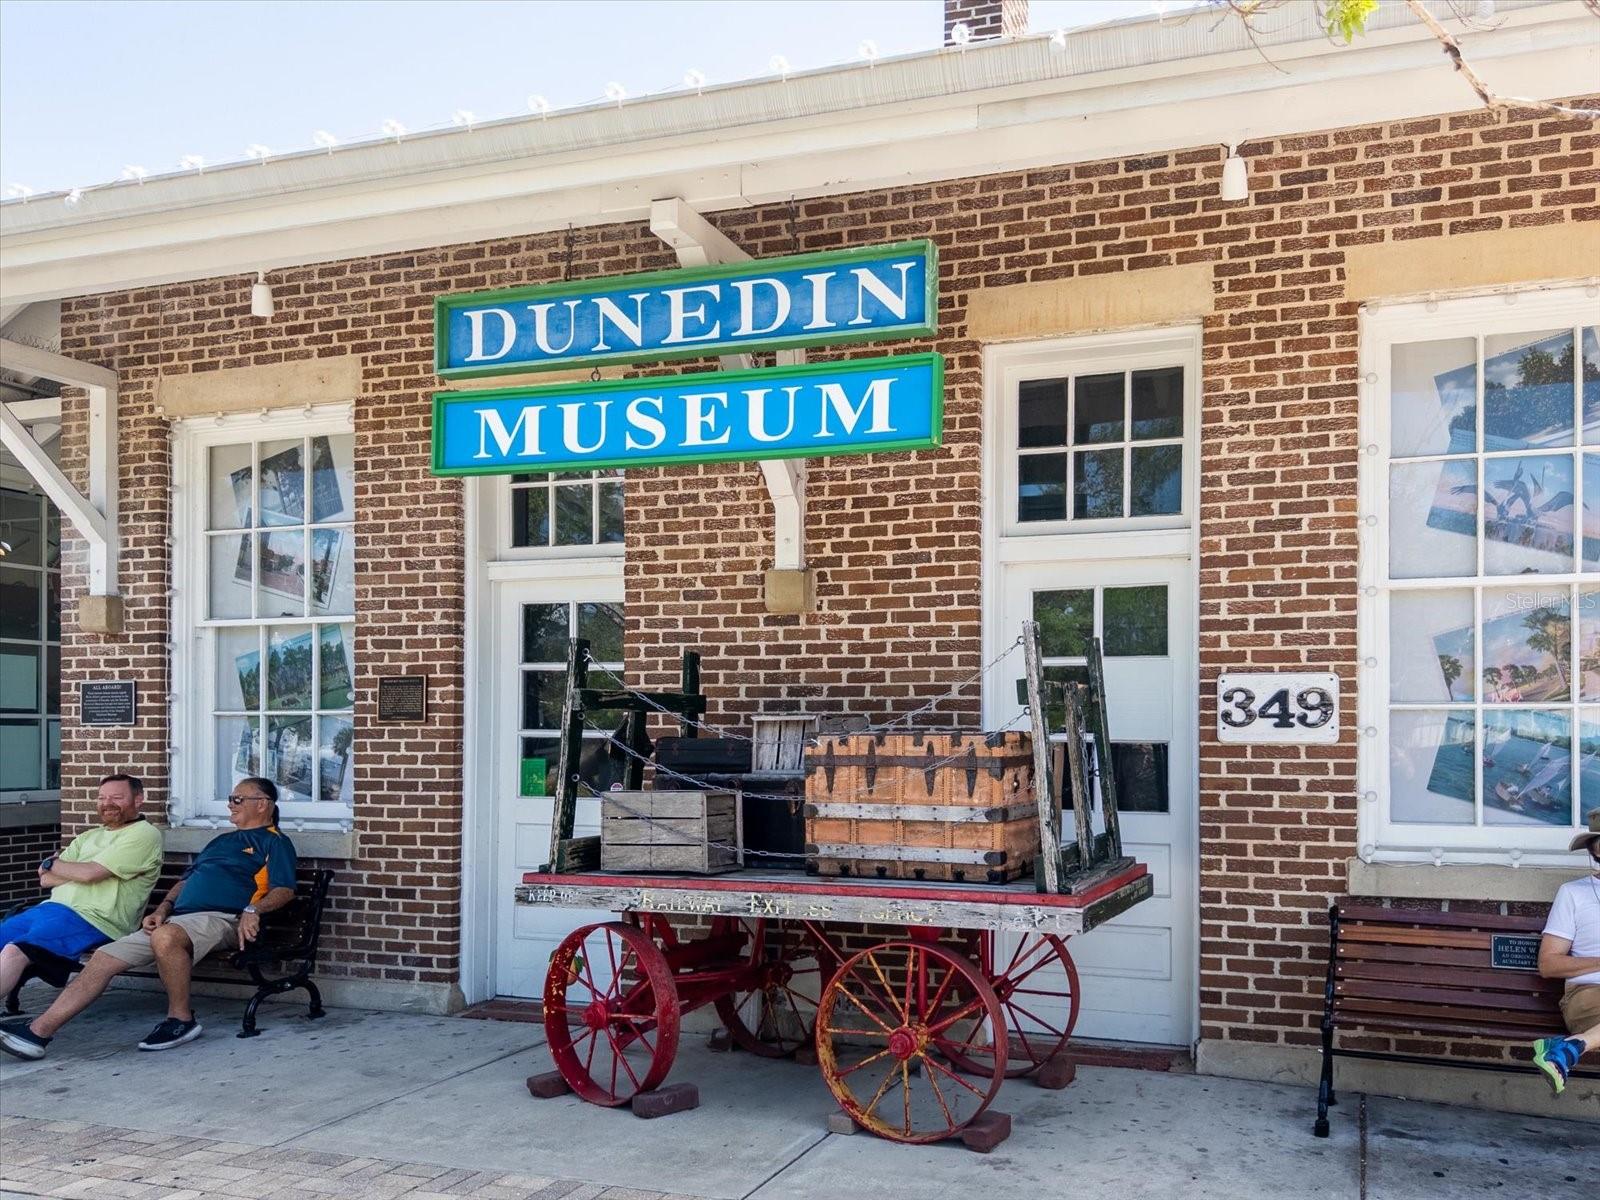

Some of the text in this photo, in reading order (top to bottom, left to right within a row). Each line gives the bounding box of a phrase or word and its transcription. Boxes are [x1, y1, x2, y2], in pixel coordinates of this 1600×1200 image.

[463, 261, 916, 362] DUNEDIN
[473, 377, 899, 459] MUSEUM
[1220, 687, 1335, 729] 349
[528, 889, 556, 902] KEEP
[642, 893, 725, 912] RAILWAY
[749, 894, 833, 918] EXRSS
[1498, 945, 1527, 953] HELEN
